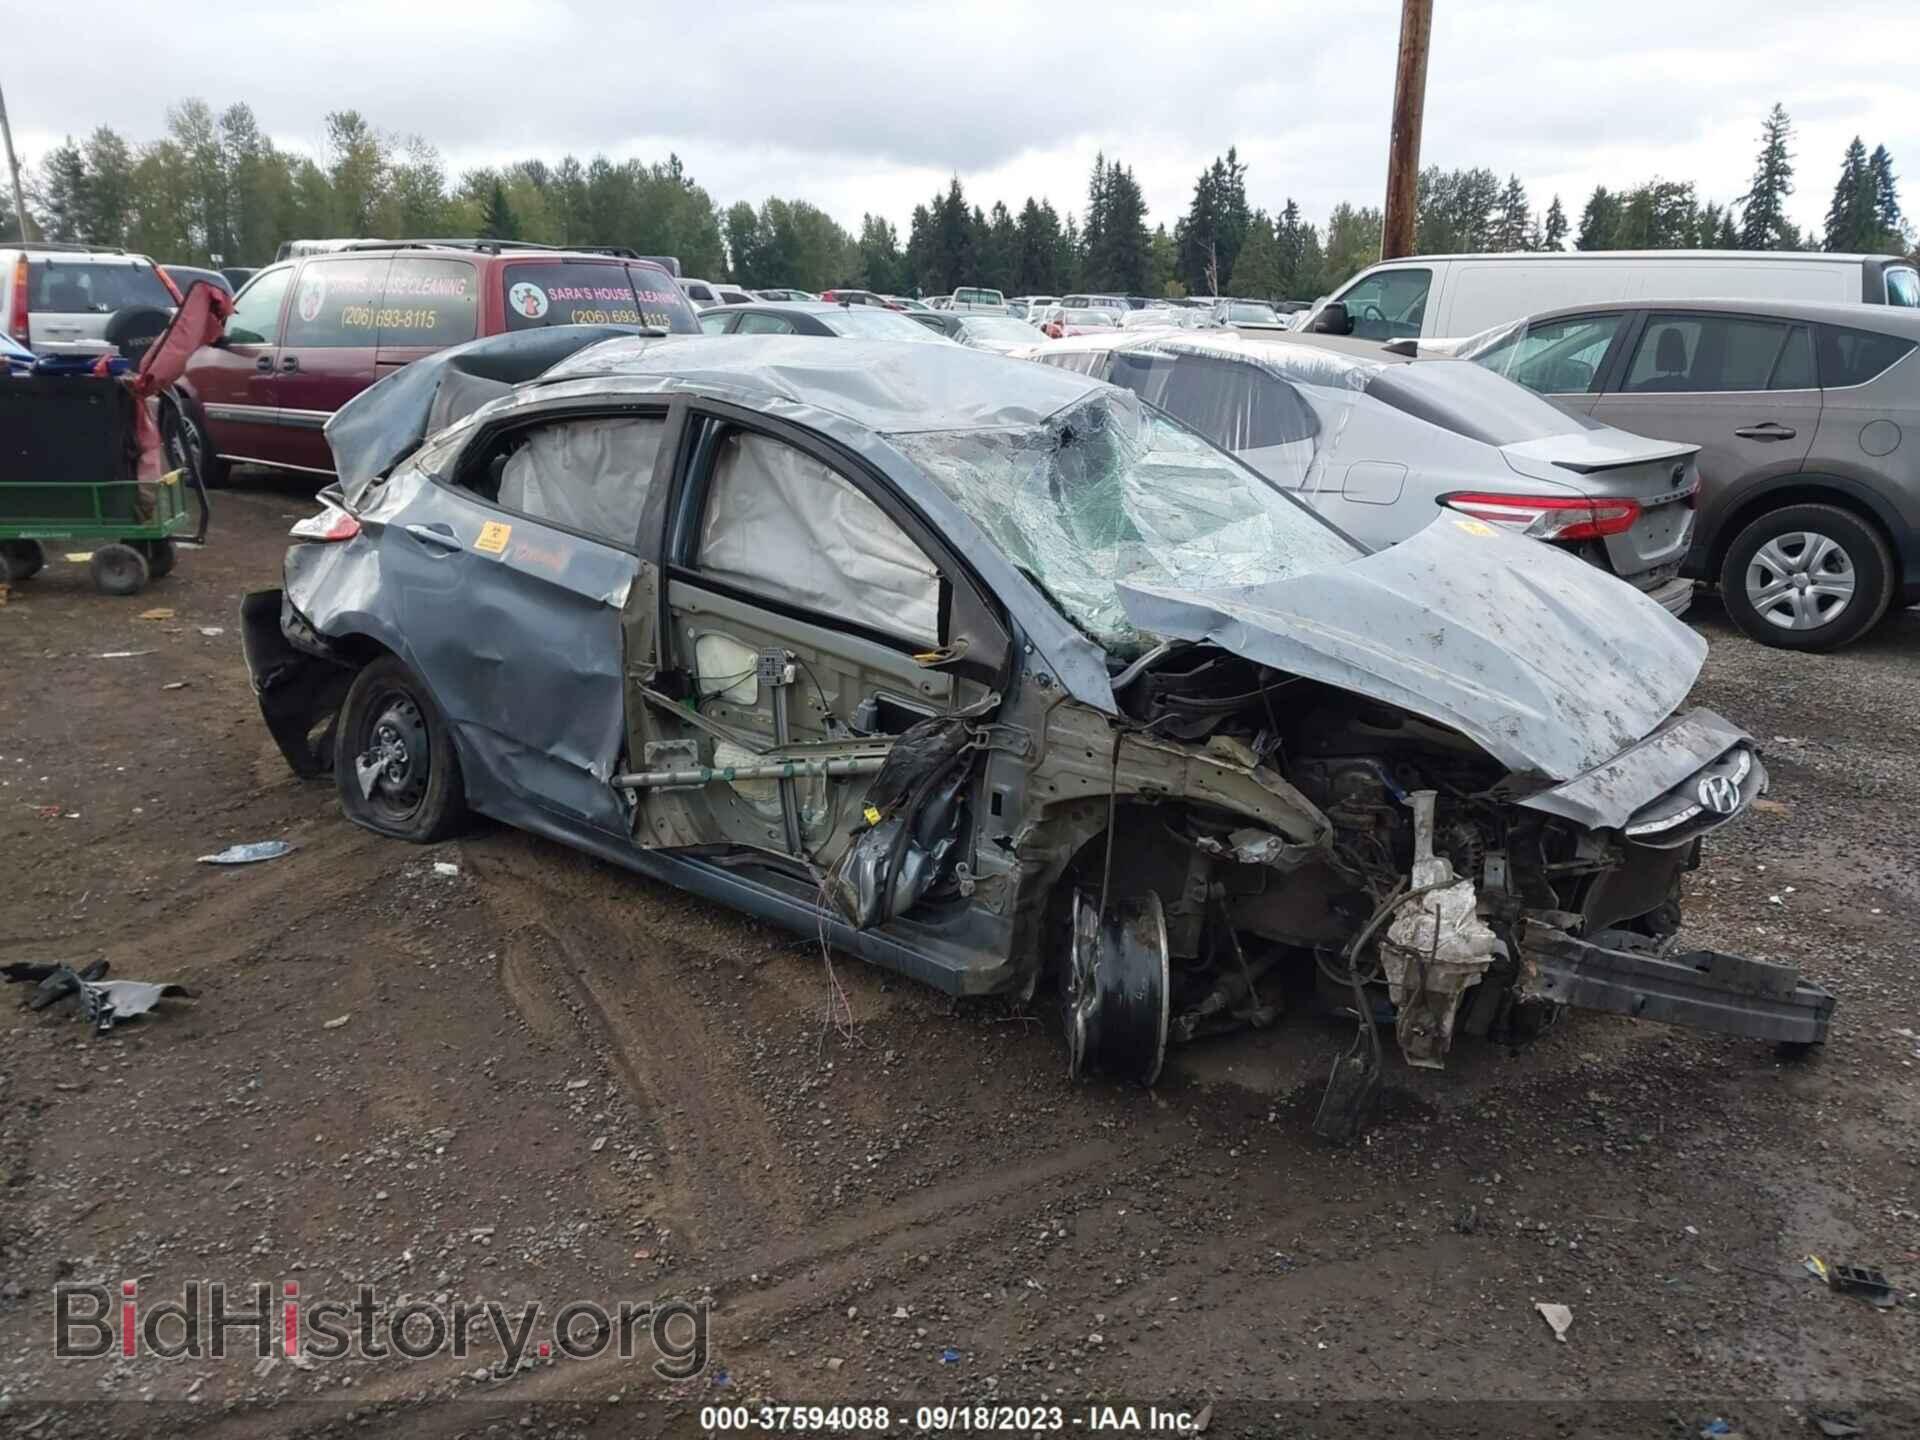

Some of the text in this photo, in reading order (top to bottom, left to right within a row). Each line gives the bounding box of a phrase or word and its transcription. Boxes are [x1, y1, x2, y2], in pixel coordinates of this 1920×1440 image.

[408, 278, 467, 295] CLEANING
[548, 287, 593, 301] SARA'S
[595, 287, 634, 301] HOUSE
[341, 306, 436, 328] (206) 693-8115
[571, 309, 610, 324] (206)
